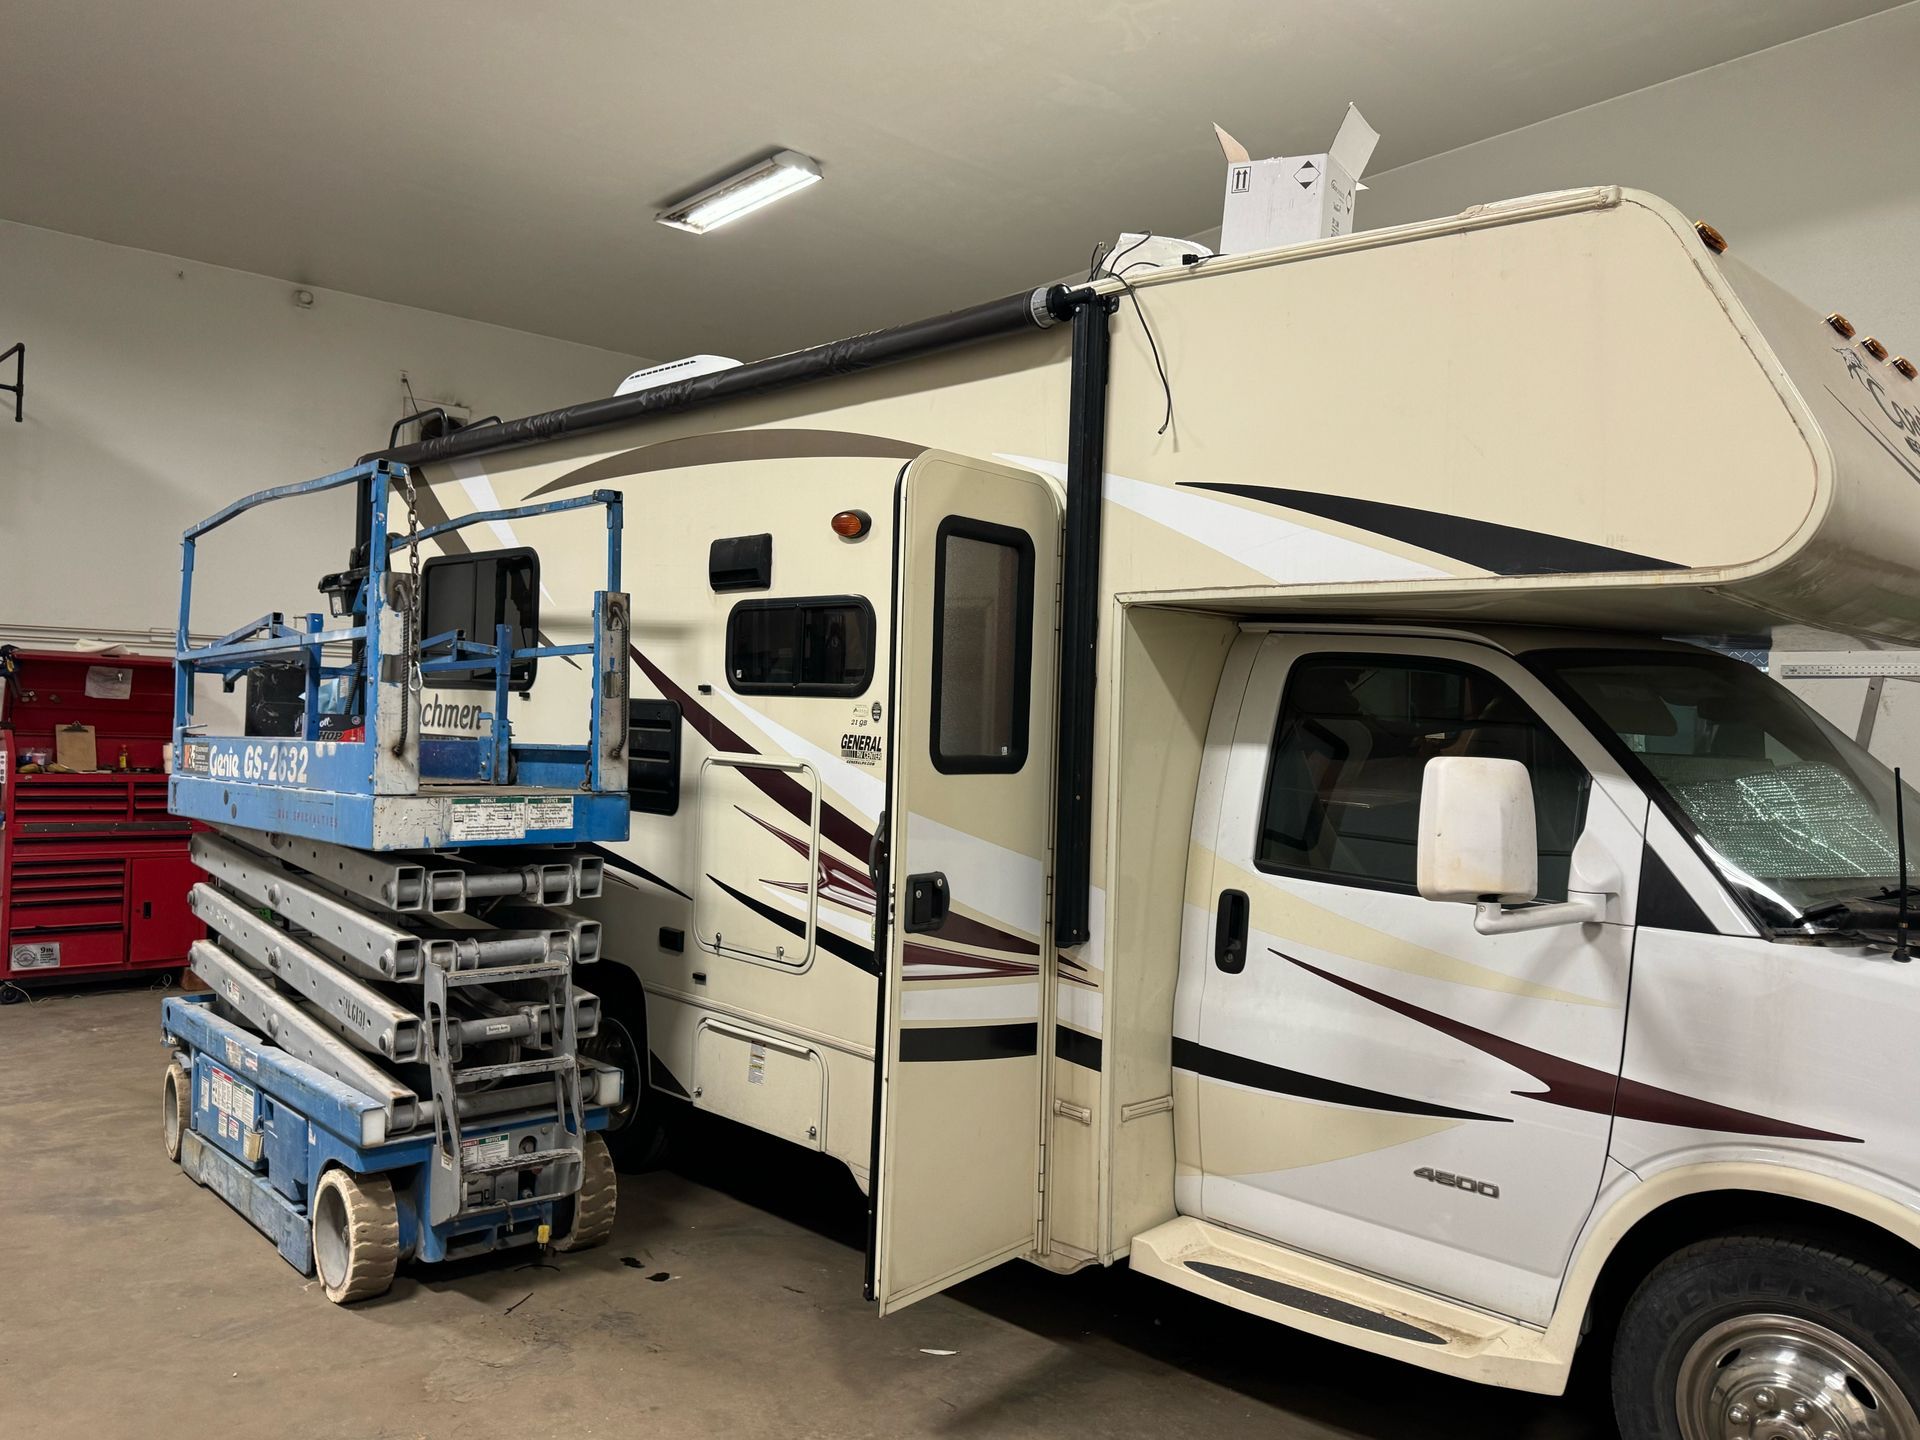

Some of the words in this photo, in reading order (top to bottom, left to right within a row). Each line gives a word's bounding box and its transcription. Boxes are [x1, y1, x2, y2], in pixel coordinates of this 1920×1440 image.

[420, 693, 482, 730] chmen
[319, 731, 344, 742] HOP
[841, 734, 882, 752] GENERAL
[209, 745, 240, 778] Genie
[243, 745, 309, 783] GS-2632
[1413, 1167, 1499, 1199] 4500
